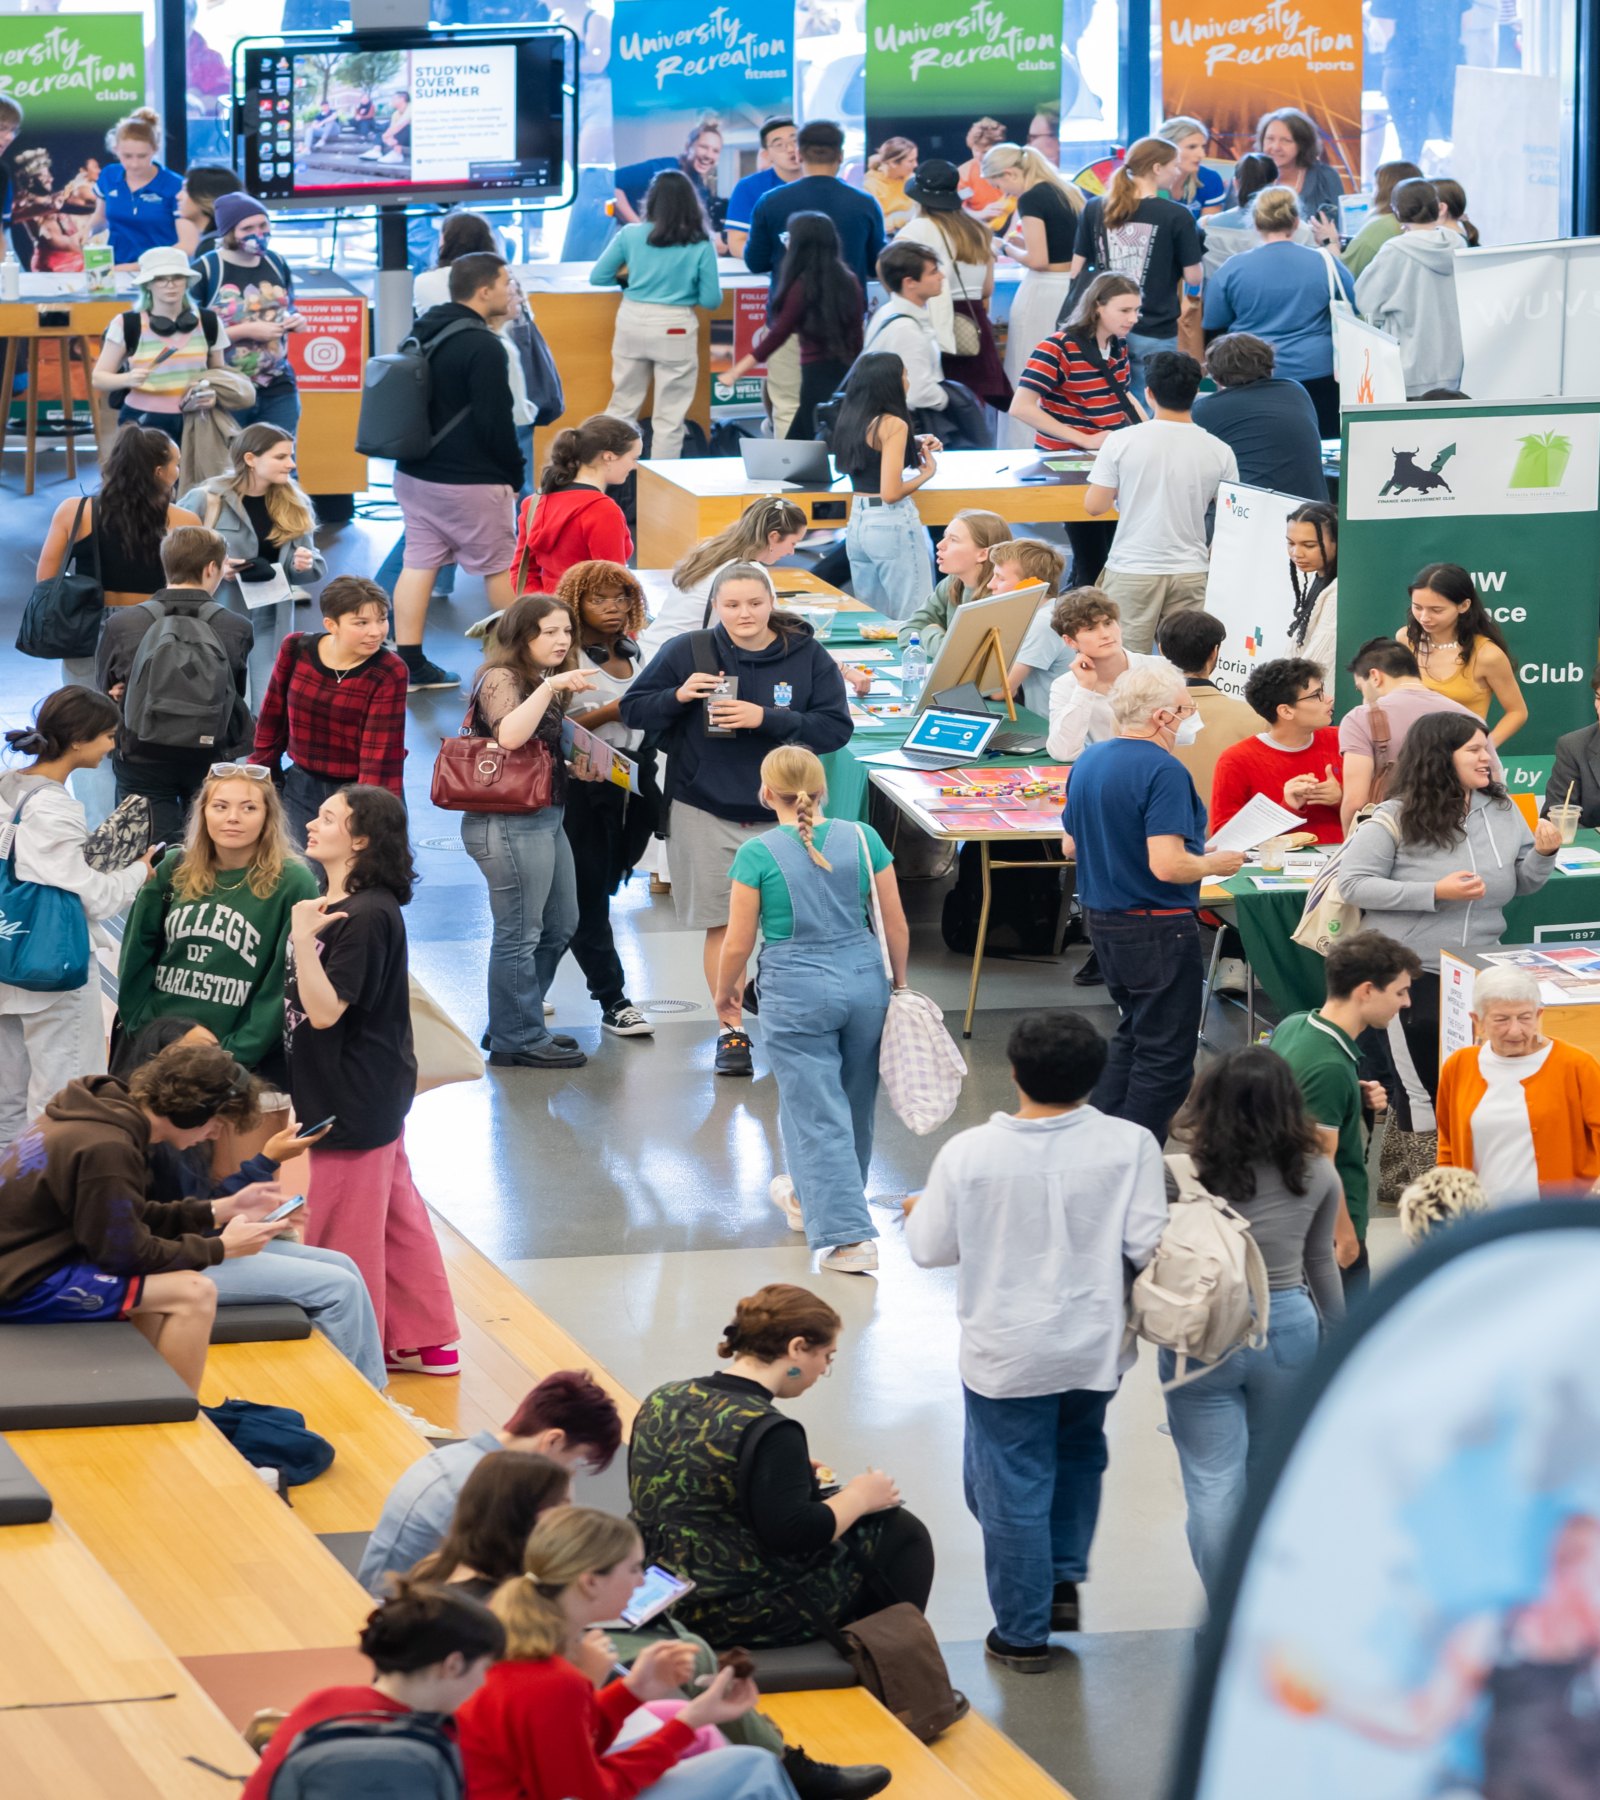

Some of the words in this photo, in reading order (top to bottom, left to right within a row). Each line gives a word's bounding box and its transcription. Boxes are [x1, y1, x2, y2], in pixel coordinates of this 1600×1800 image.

[874, 0, 1007, 53] University
[1169, 0, 1304, 47] University
[619, 6, 742, 61] University
[909, 26, 1055, 82] Recreation
[1204, 25, 1353, 77] Recreation
[655, 32, 786, 90] Recreation
[1017, 60, 1056, 71] clubs
[1306, 61, 1355, 73] sports
[415, 64, 490, 77] STUDYING
[744, 68, 788, 80] fitness
[415, 76, 455, 88] OVER
[95, 89, 138, 101] clubs
[415, 86, 480, 98] SUMMER
[345, 315, 358, 323] TO
[1231, 505, 1250, 519] VBC
[1519, 661, 1584, 684] Club
[1514, 768, 1543, 789] by
[1569, 931, 1596, 940] 1897
[187, 943, 212, 963] OF
[155, 964, 253, 1007] HARLESTON
